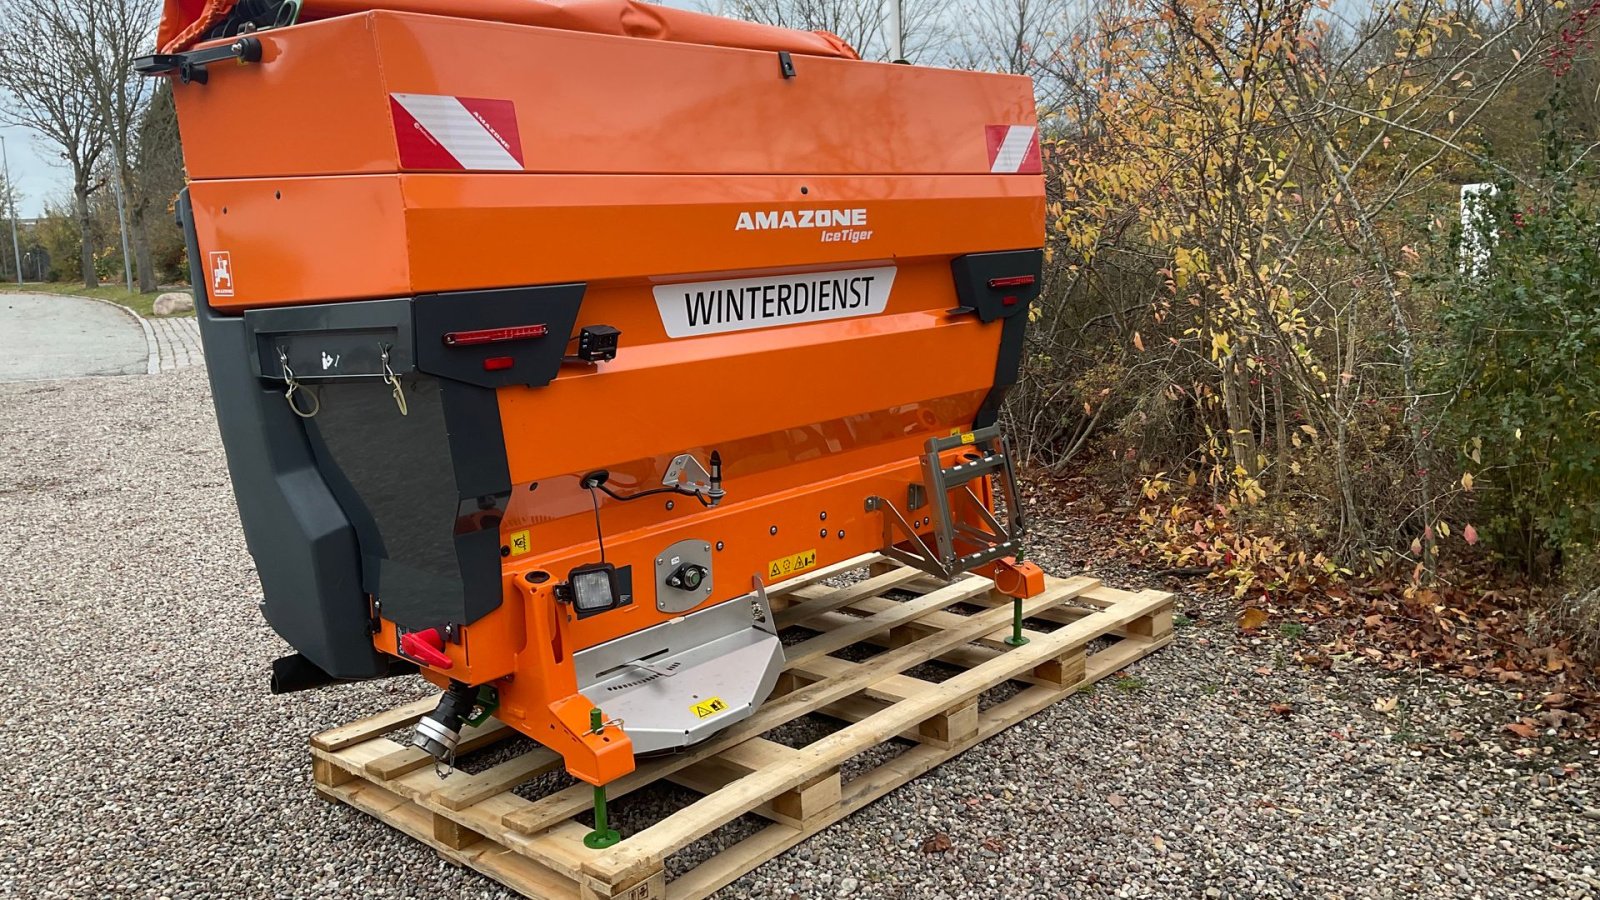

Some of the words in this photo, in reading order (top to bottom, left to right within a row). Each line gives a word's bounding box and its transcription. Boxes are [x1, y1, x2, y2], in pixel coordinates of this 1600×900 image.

[473, 111, 510, 150] AMAZONE
[735, 208, 867, 230] AMAZONE
[820, 229, 873, 243] IceTiger
[685, 276, 875, 327] WINTERDIENST
